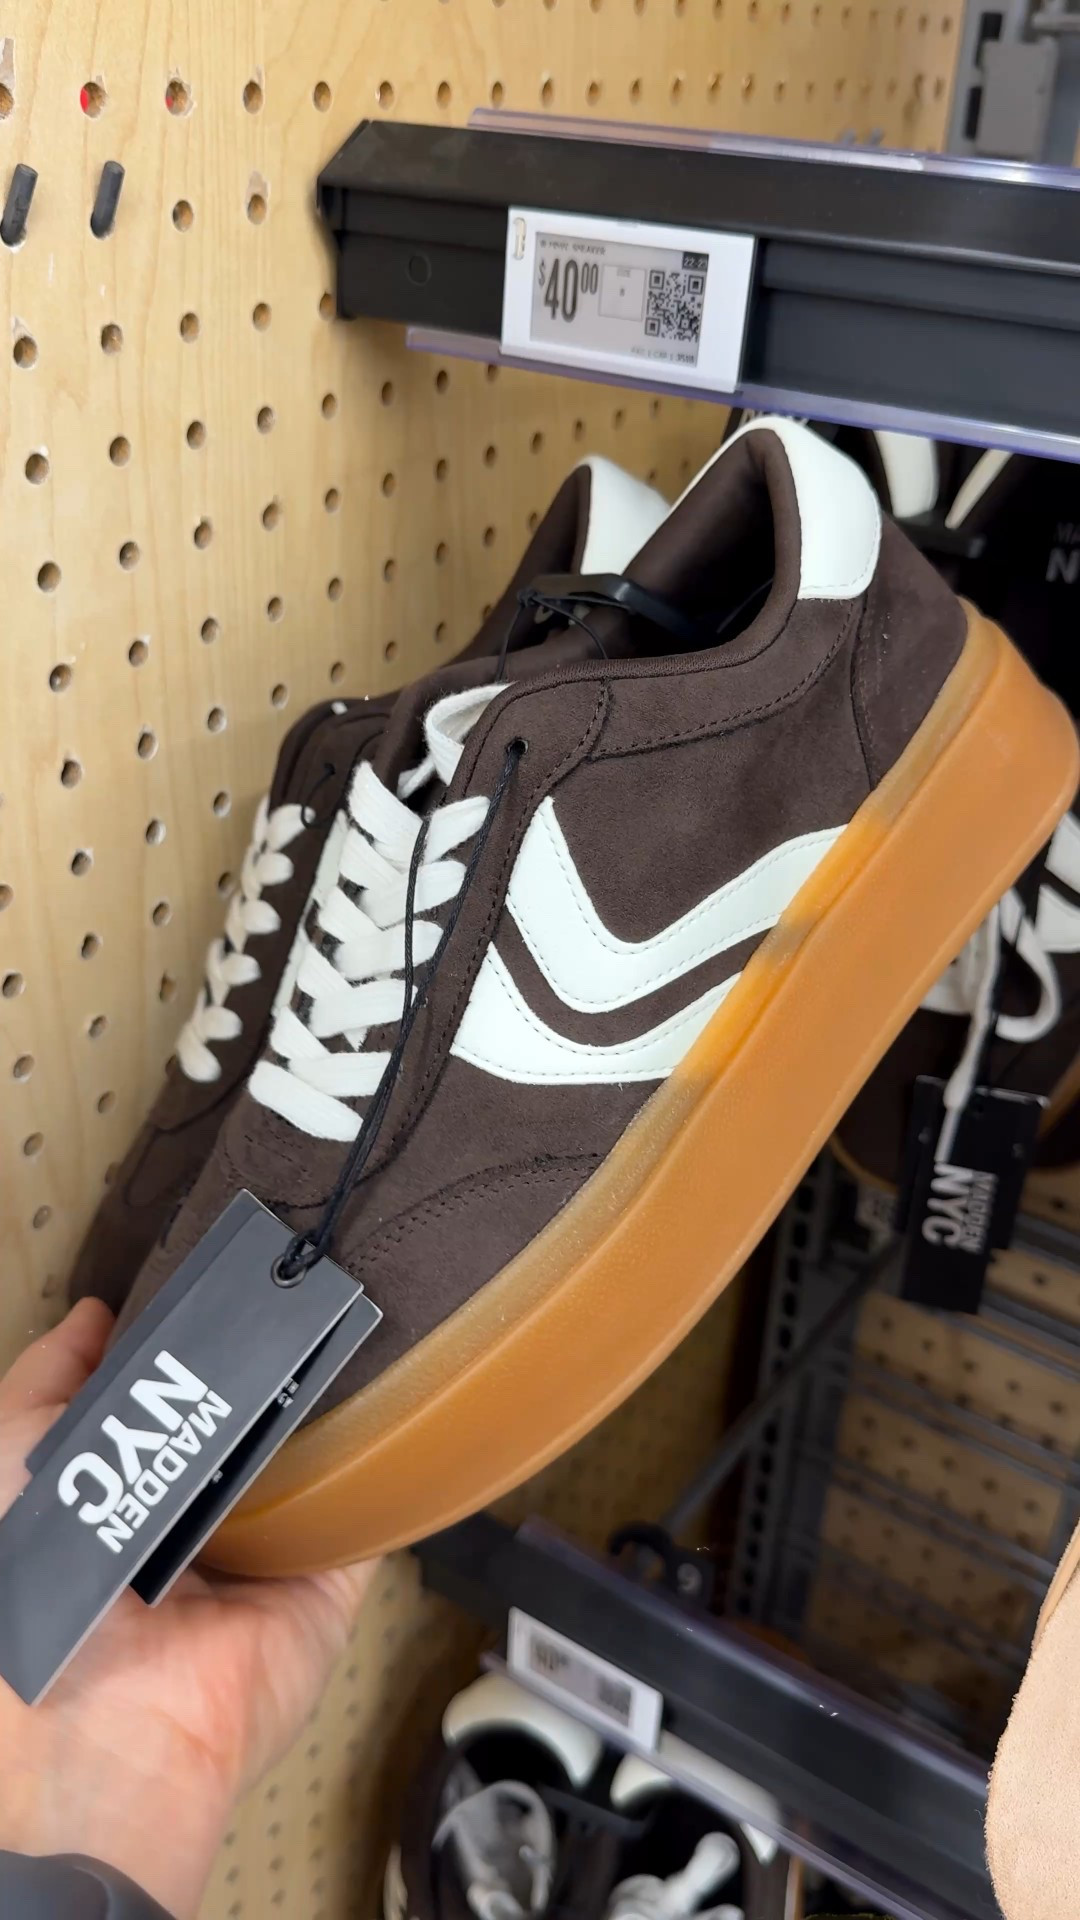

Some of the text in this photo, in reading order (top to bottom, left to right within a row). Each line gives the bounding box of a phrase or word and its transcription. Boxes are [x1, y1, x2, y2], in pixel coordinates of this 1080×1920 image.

[921, 1162, 973, 1249] NYC
[57, 1350, 209, 1525] NYC
[96, 1389, 233, 1554] MADDEN
